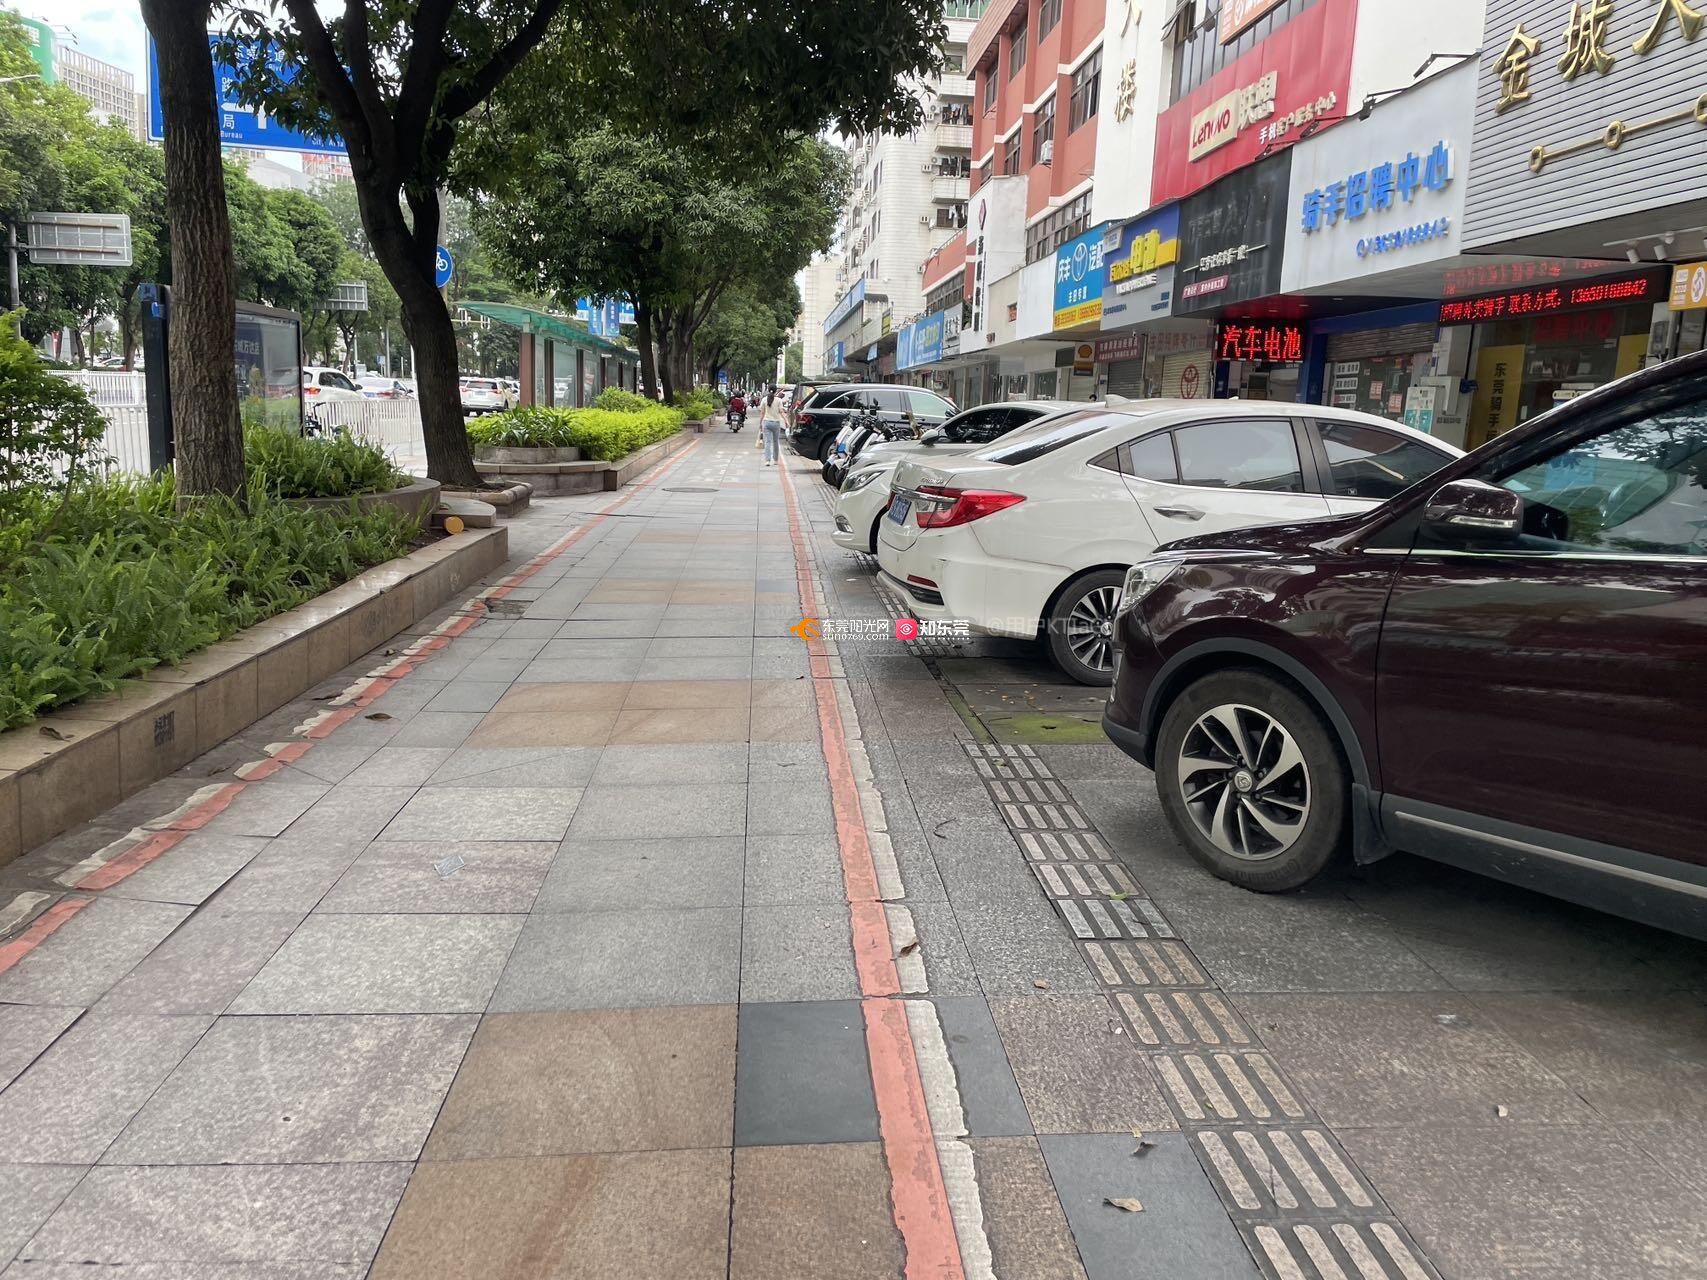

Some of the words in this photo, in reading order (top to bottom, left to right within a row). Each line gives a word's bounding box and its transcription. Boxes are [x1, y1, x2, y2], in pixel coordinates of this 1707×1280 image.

[220, 130, 244, 140] Bureau
[223, 114, 235, 131] 局
[1192, 108, 1231, 149] Lenovo
[1301, 140, 1454, 234] 骑手招聘中心
[1222, 325, 1302, 360] 汽车电池
